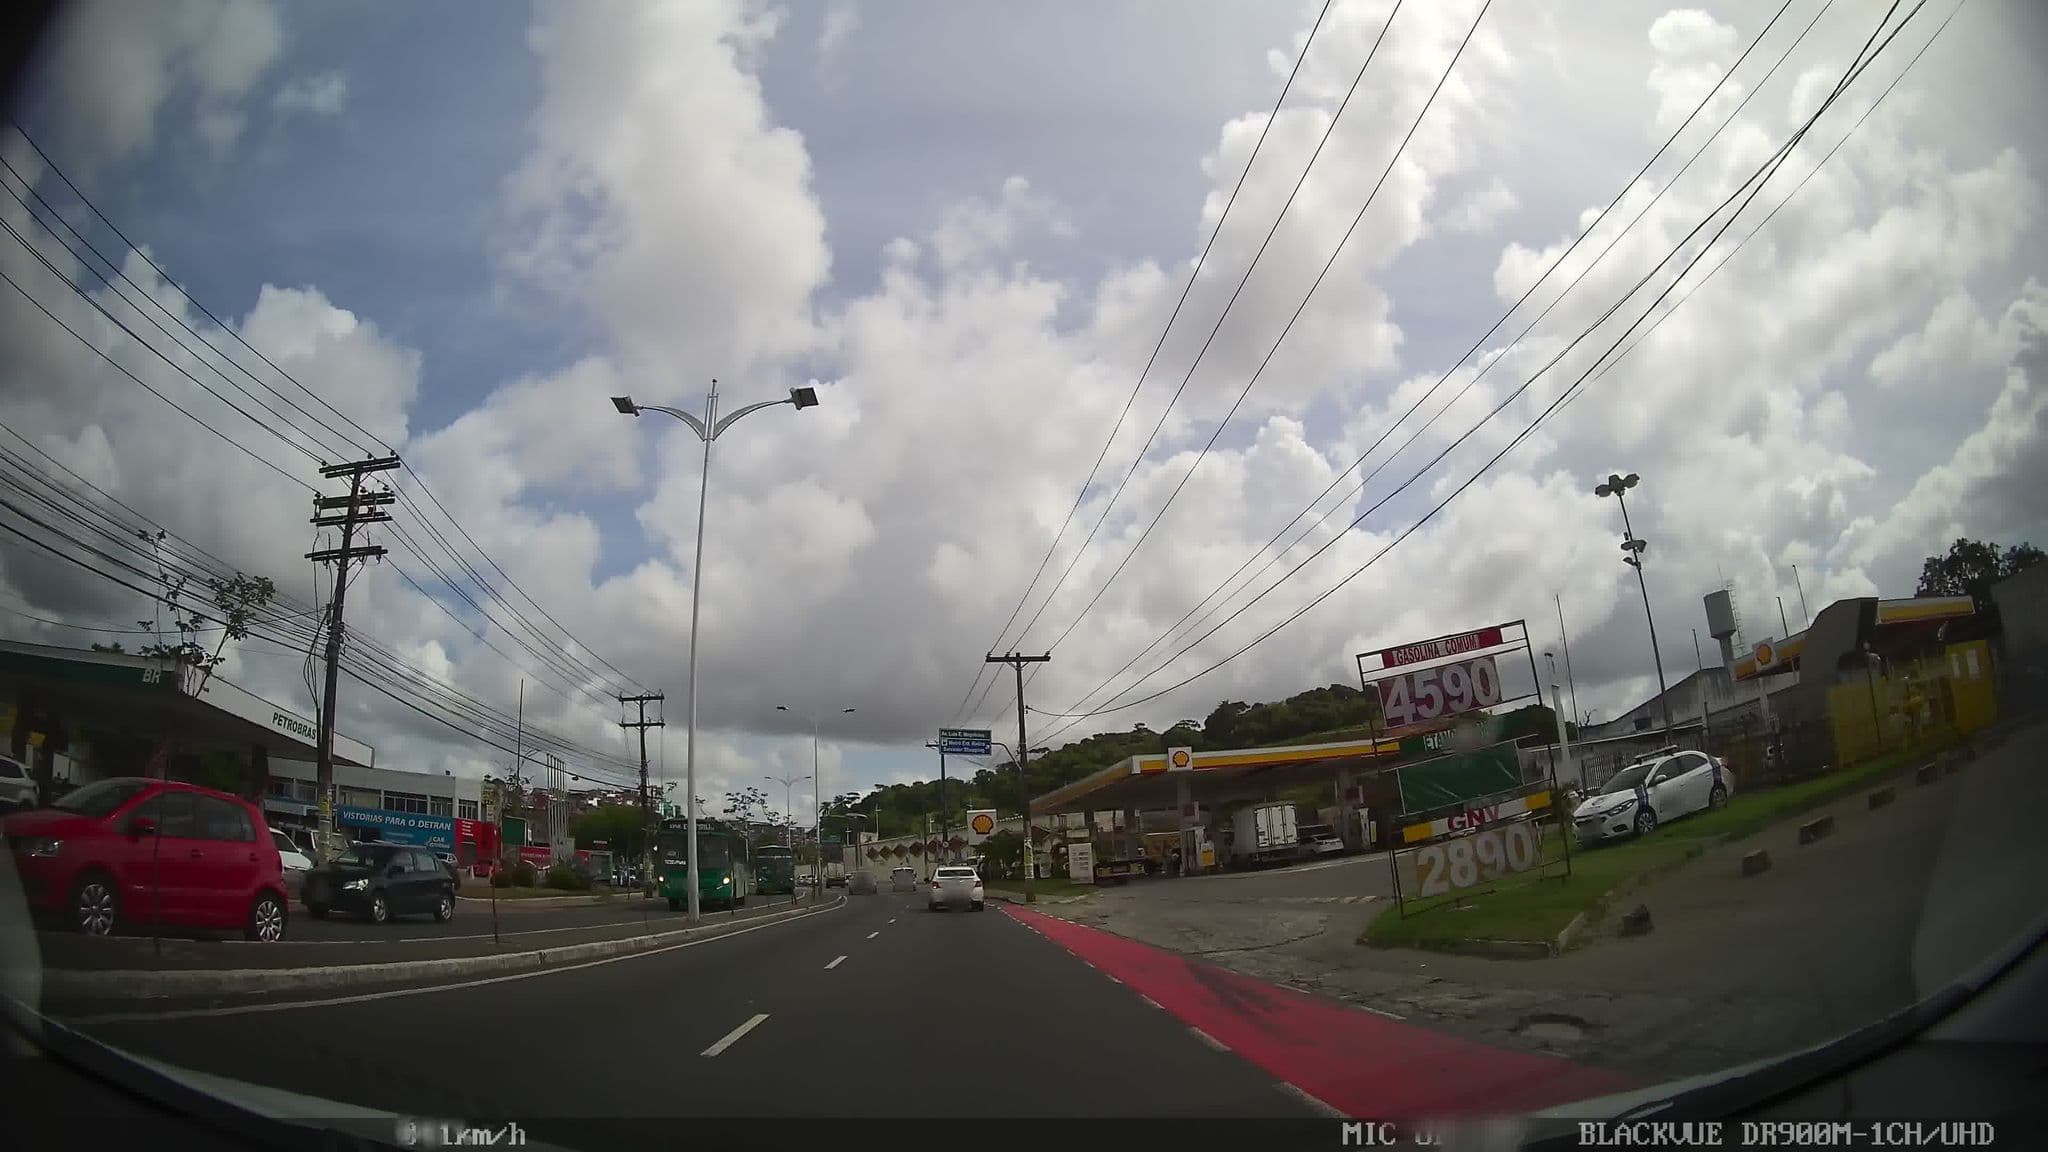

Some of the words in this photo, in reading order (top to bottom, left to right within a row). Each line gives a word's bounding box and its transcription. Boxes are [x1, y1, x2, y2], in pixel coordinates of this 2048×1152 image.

[1395, 641, 1440, 665] GASOLINA
[1445, 633, 1478, 654] COMUM
[142, 668, 163, 684] BR
[1384, 657, 1501, 726] 4590
[272, 711, 317, 741] PETROBRAS
[343, 811, 383, 824] VISTORIAS
[384, 816, 406, 827] PARA
[408, 819, 416, 828] O
[417, 820, 451, 831] DETRAN
[1447, 804, 1500, 832] GNV
[1416, 822, 1536, 897] 2890
